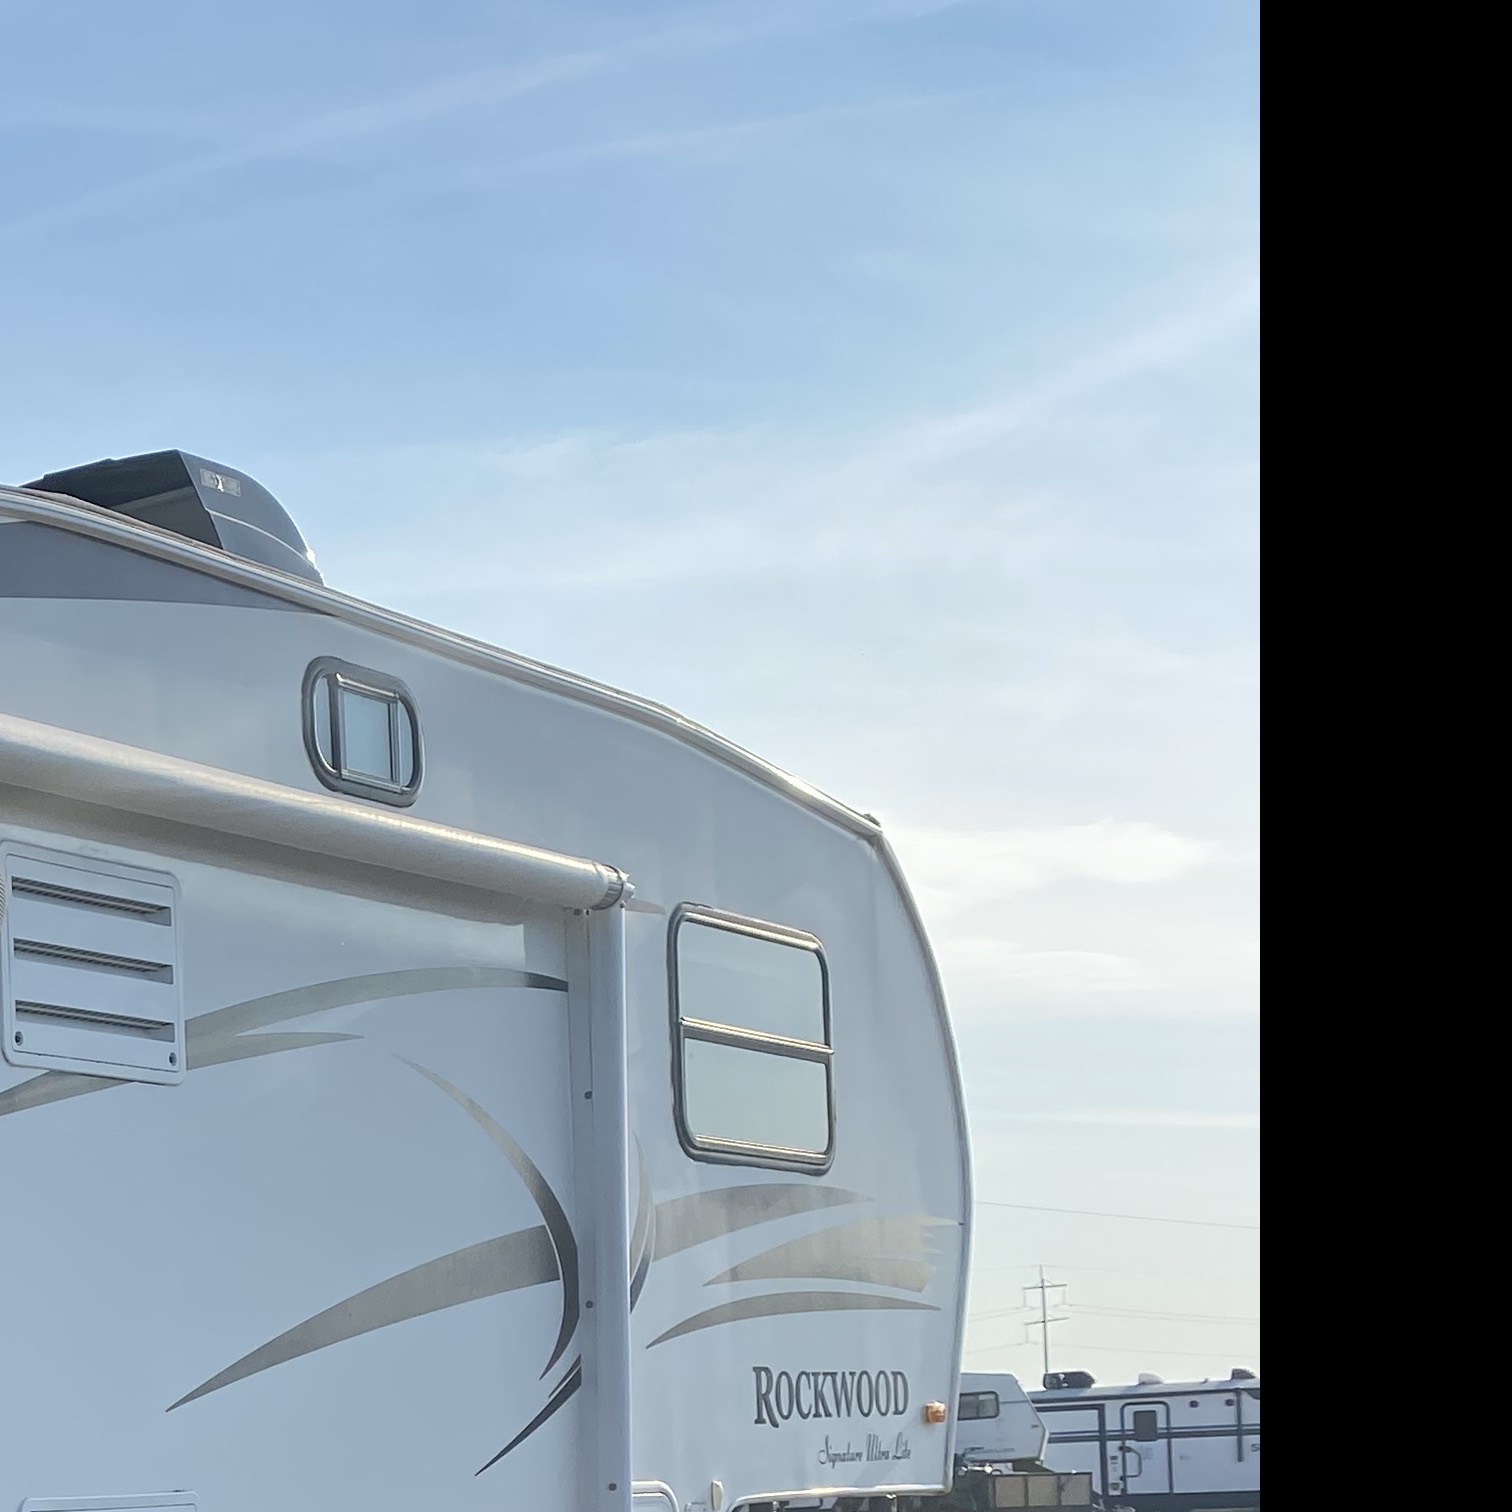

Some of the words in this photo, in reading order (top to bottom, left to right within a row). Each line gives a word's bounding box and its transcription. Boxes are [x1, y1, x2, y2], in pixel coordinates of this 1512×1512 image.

[752, 1366, 909, 1429] ROCKWOOD
[818, 1434, 864, 1470] Signature
[866, 1432, 890, 1462] Ultra
[892, 1431, 912, 1460] Lite
